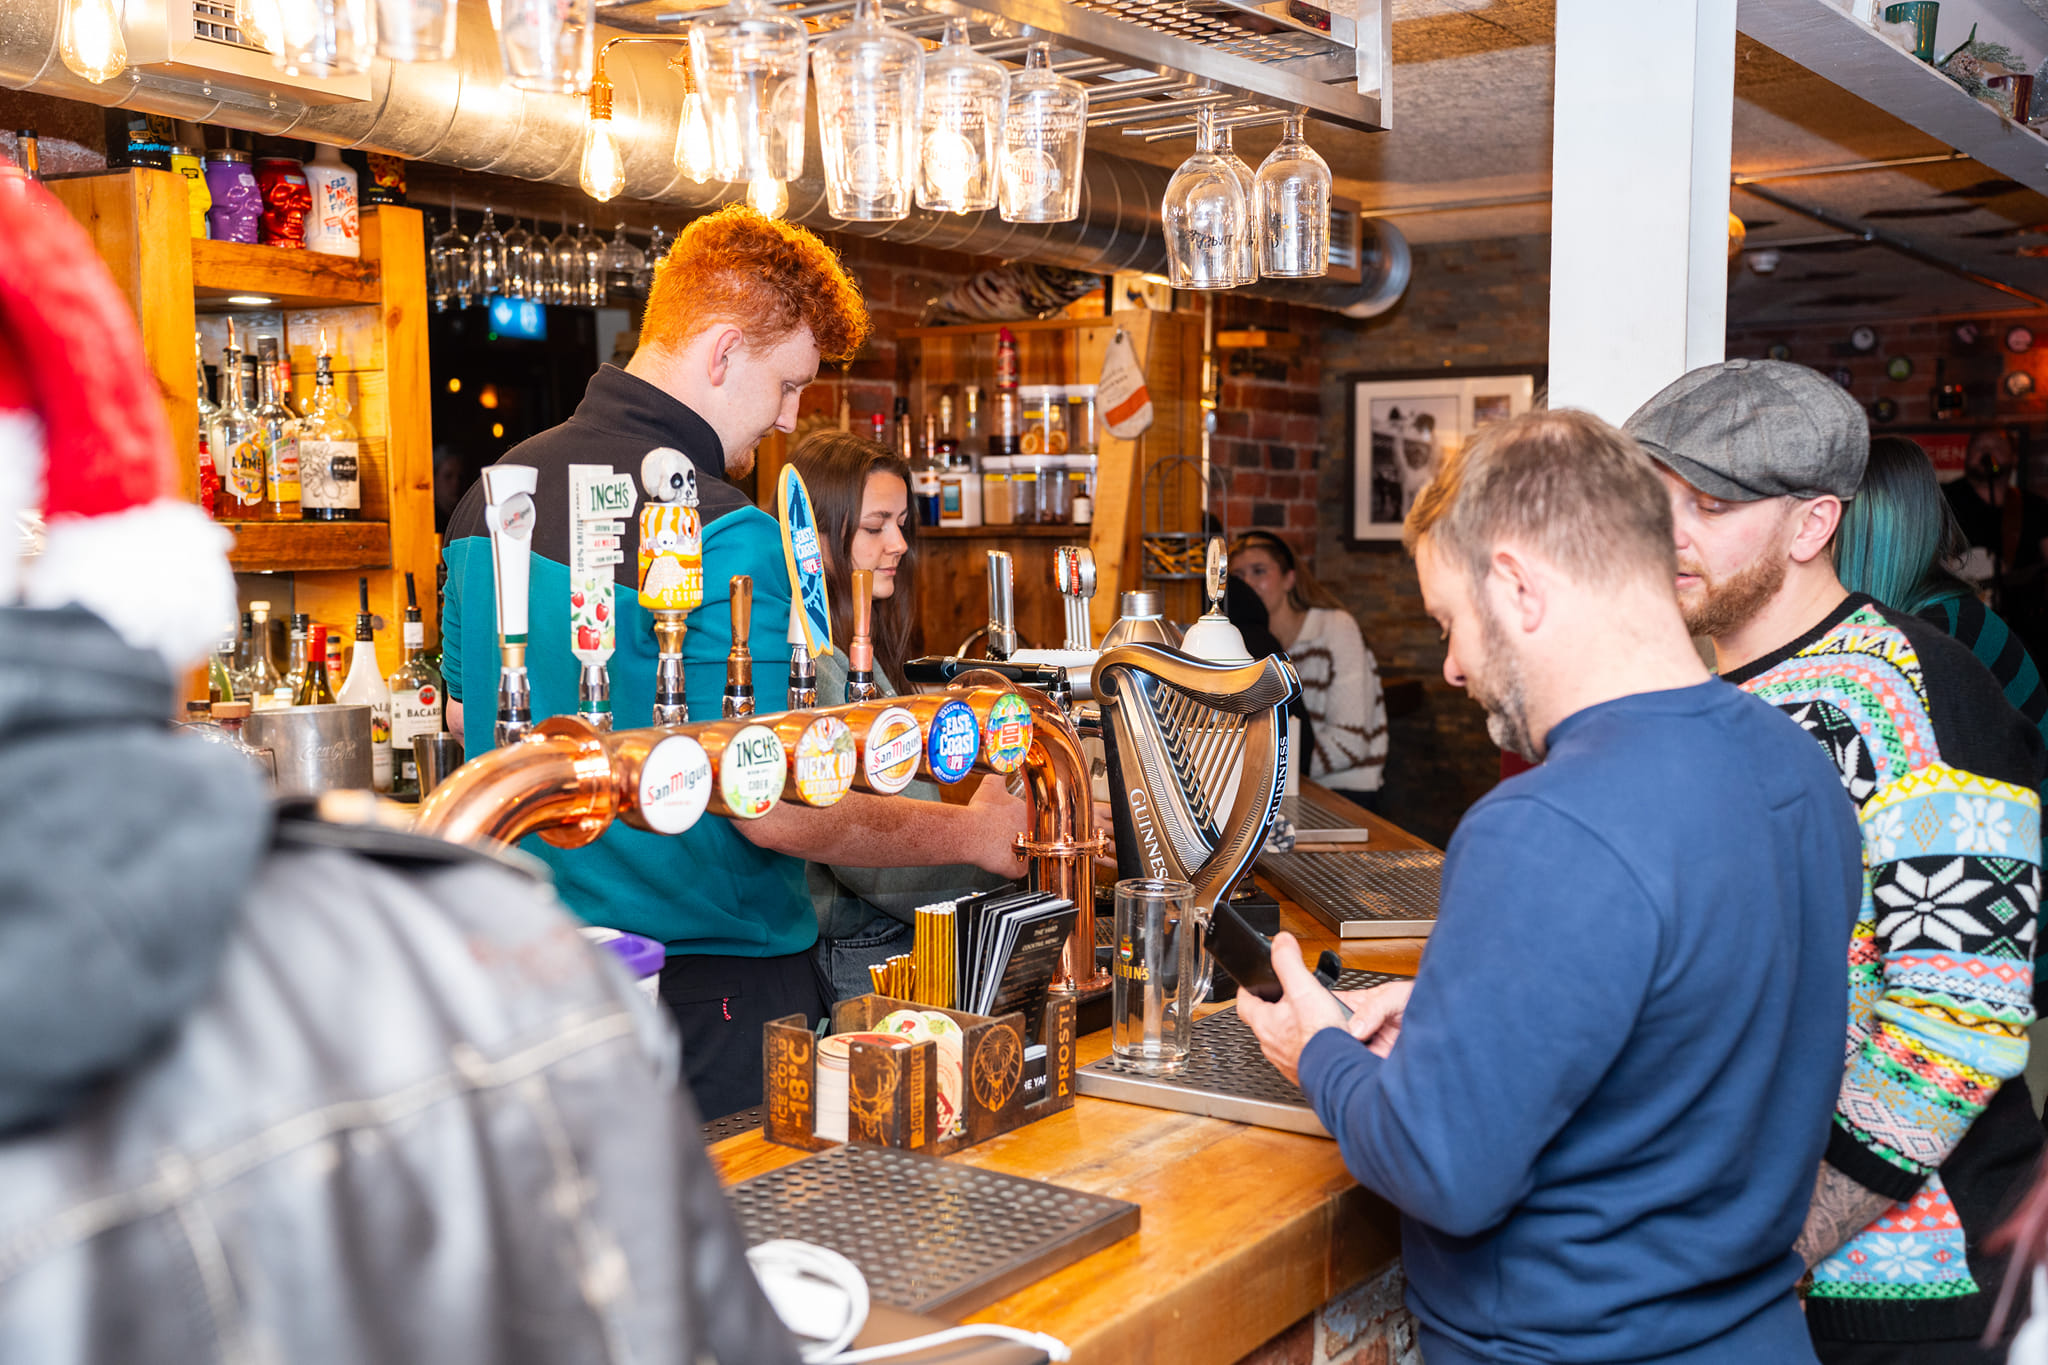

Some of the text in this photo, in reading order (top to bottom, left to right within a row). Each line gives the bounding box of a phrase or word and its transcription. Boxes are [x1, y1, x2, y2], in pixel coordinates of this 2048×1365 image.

[590, 482, 630, 512] INCH'S
[736, 735, 780, 768] INCH'S
[946, 714, 970, 735] EAST
[1266, 736, 1288, 826] GUINNESS
[1129, 788, 1169, 880] GUINNES
[777, 1037, 788, 1125] ICE COLD
[1058, 1002, 1071, 1097] PROST!
